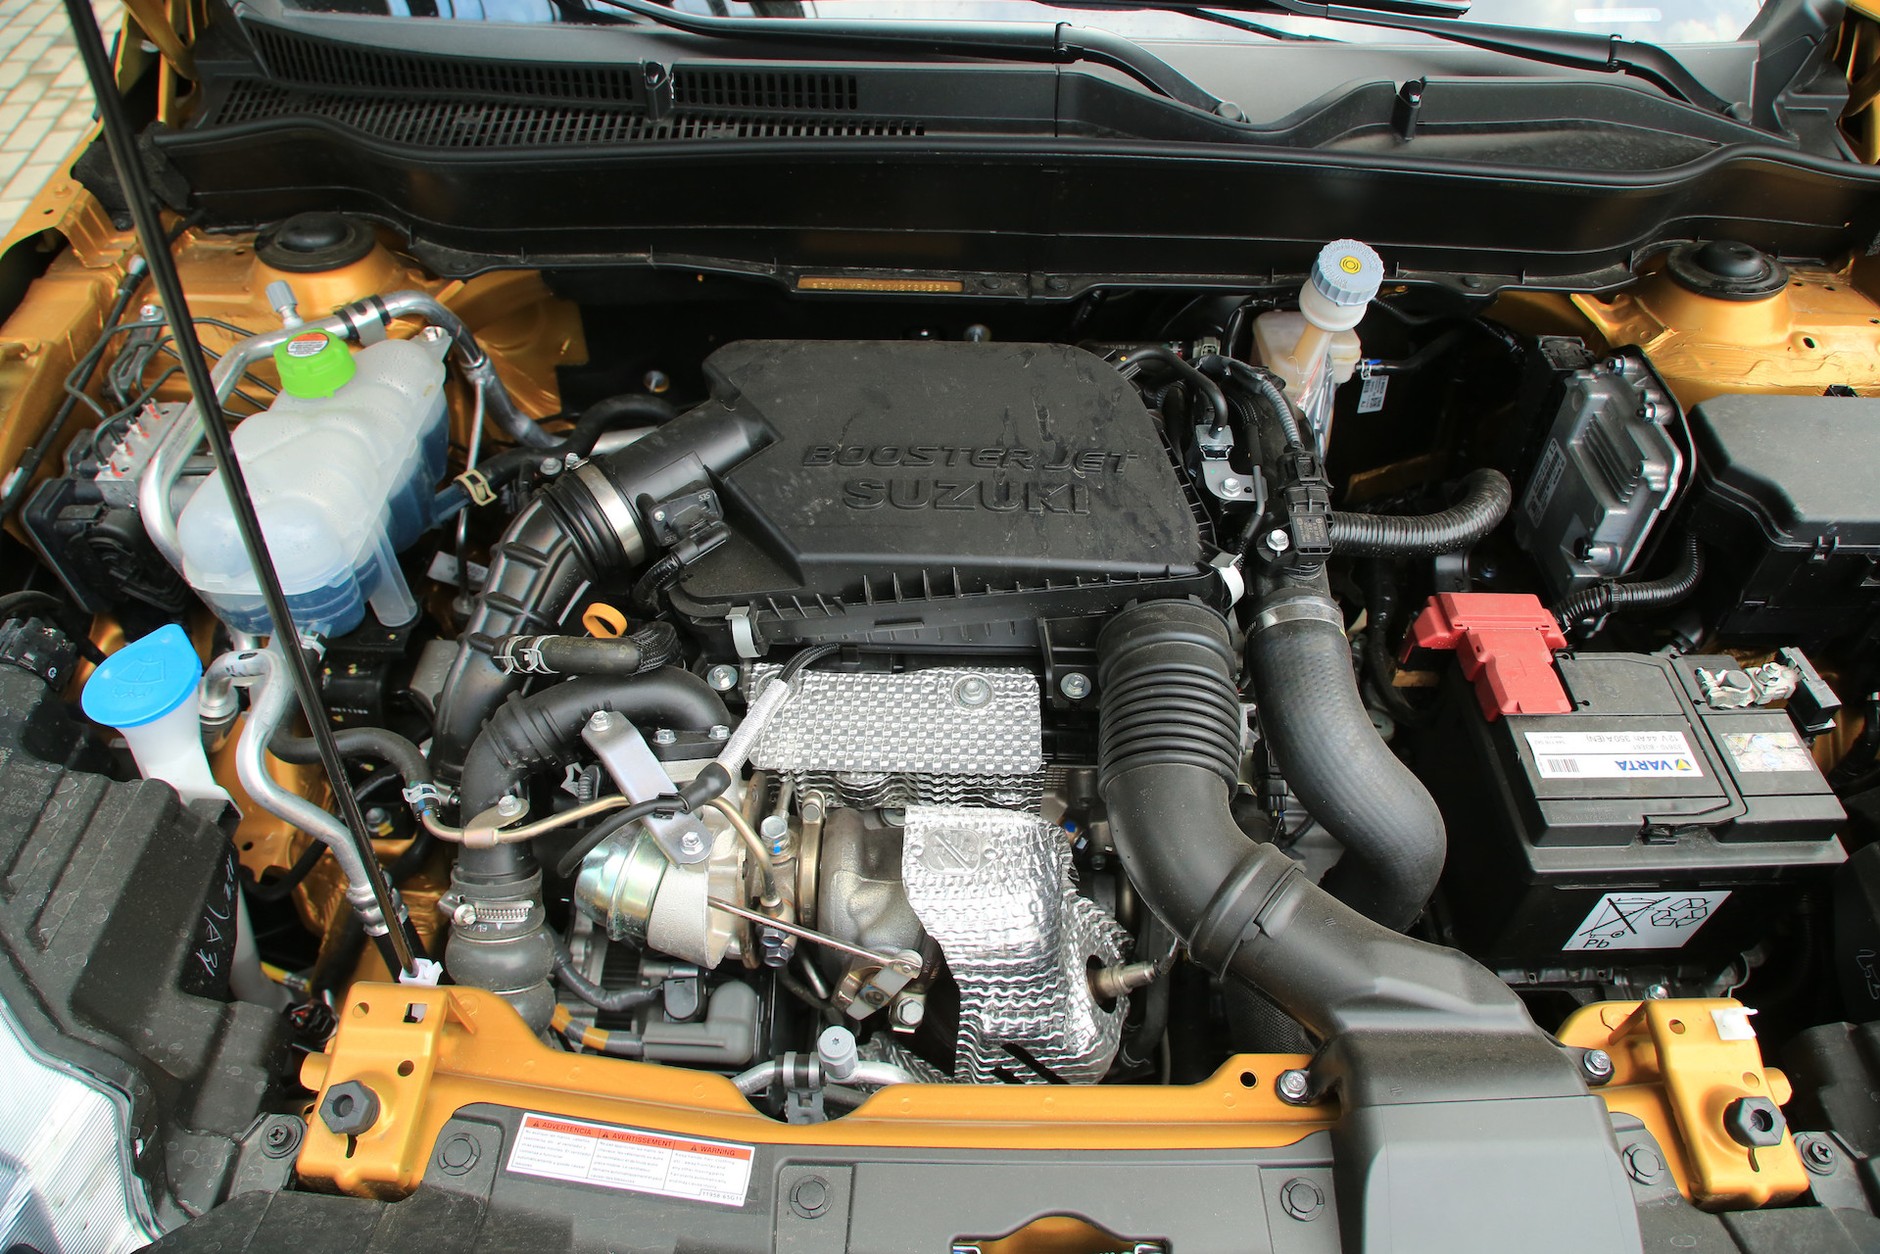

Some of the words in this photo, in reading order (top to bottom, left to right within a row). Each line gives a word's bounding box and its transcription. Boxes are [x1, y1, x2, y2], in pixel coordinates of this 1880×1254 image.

[803, 444, 1035, 470] BOOSTER
[1043, 448, 1139, 476] JET
[842, 478, 1090, 516] SUZUKI
[1614, 760, 1673, 771] VARTA
[1583, 938, 1610, 948] Pb
[542, 1121, 592, 1135] ADVERTENCIA
[612, 1133, 672, 1147] AVERTISSEMENT
[700, 1145, 735, 1156] WARNING
